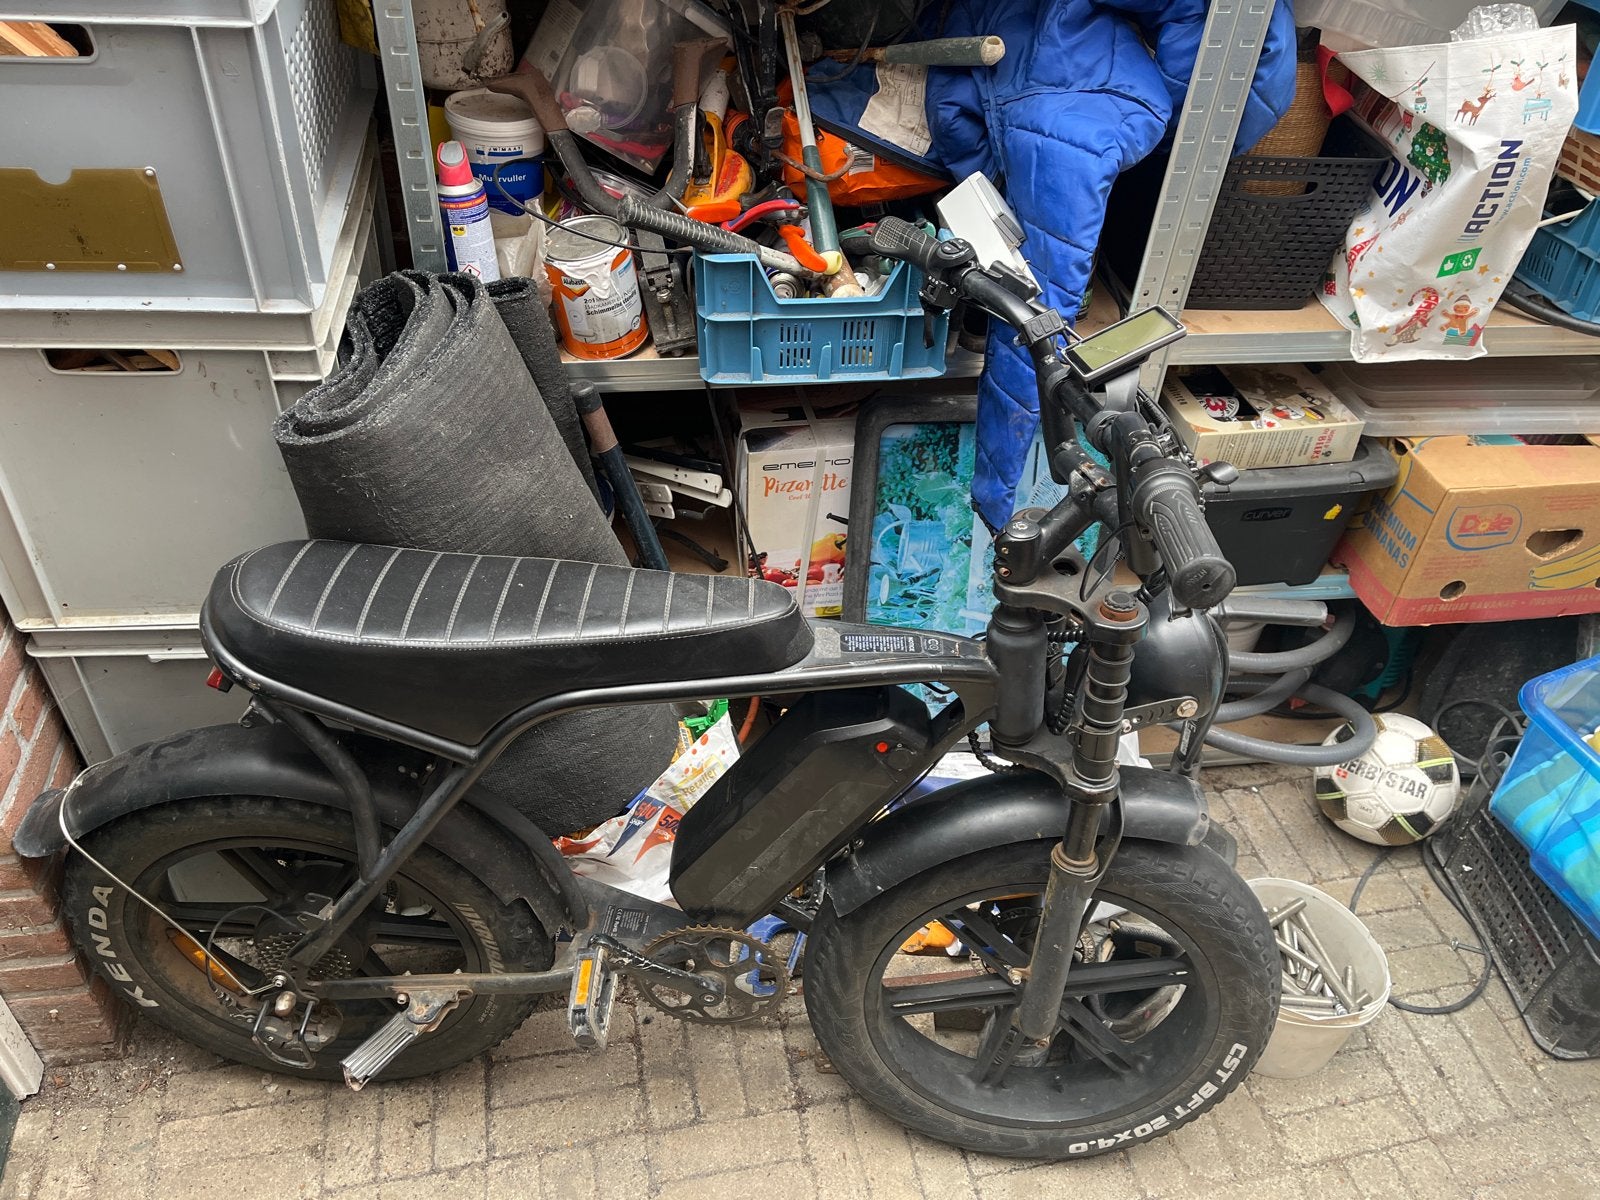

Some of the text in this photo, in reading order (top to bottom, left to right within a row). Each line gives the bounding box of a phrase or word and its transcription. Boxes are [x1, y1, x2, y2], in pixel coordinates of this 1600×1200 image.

[478, 173, 527, 183] Murvuller
[1464, 140, 1523, 234] ACTION
[762, 473, 848, 497] Pizzartte
[1363, 510, 1410, 569] BANANAS
[1457, 512, 1514, 534] Dole
[88, 885, 160, 1007] KENDA
[1215, 1042, 1248, 1083] CST
[1173, 1081, 1219, 1120] BFT
